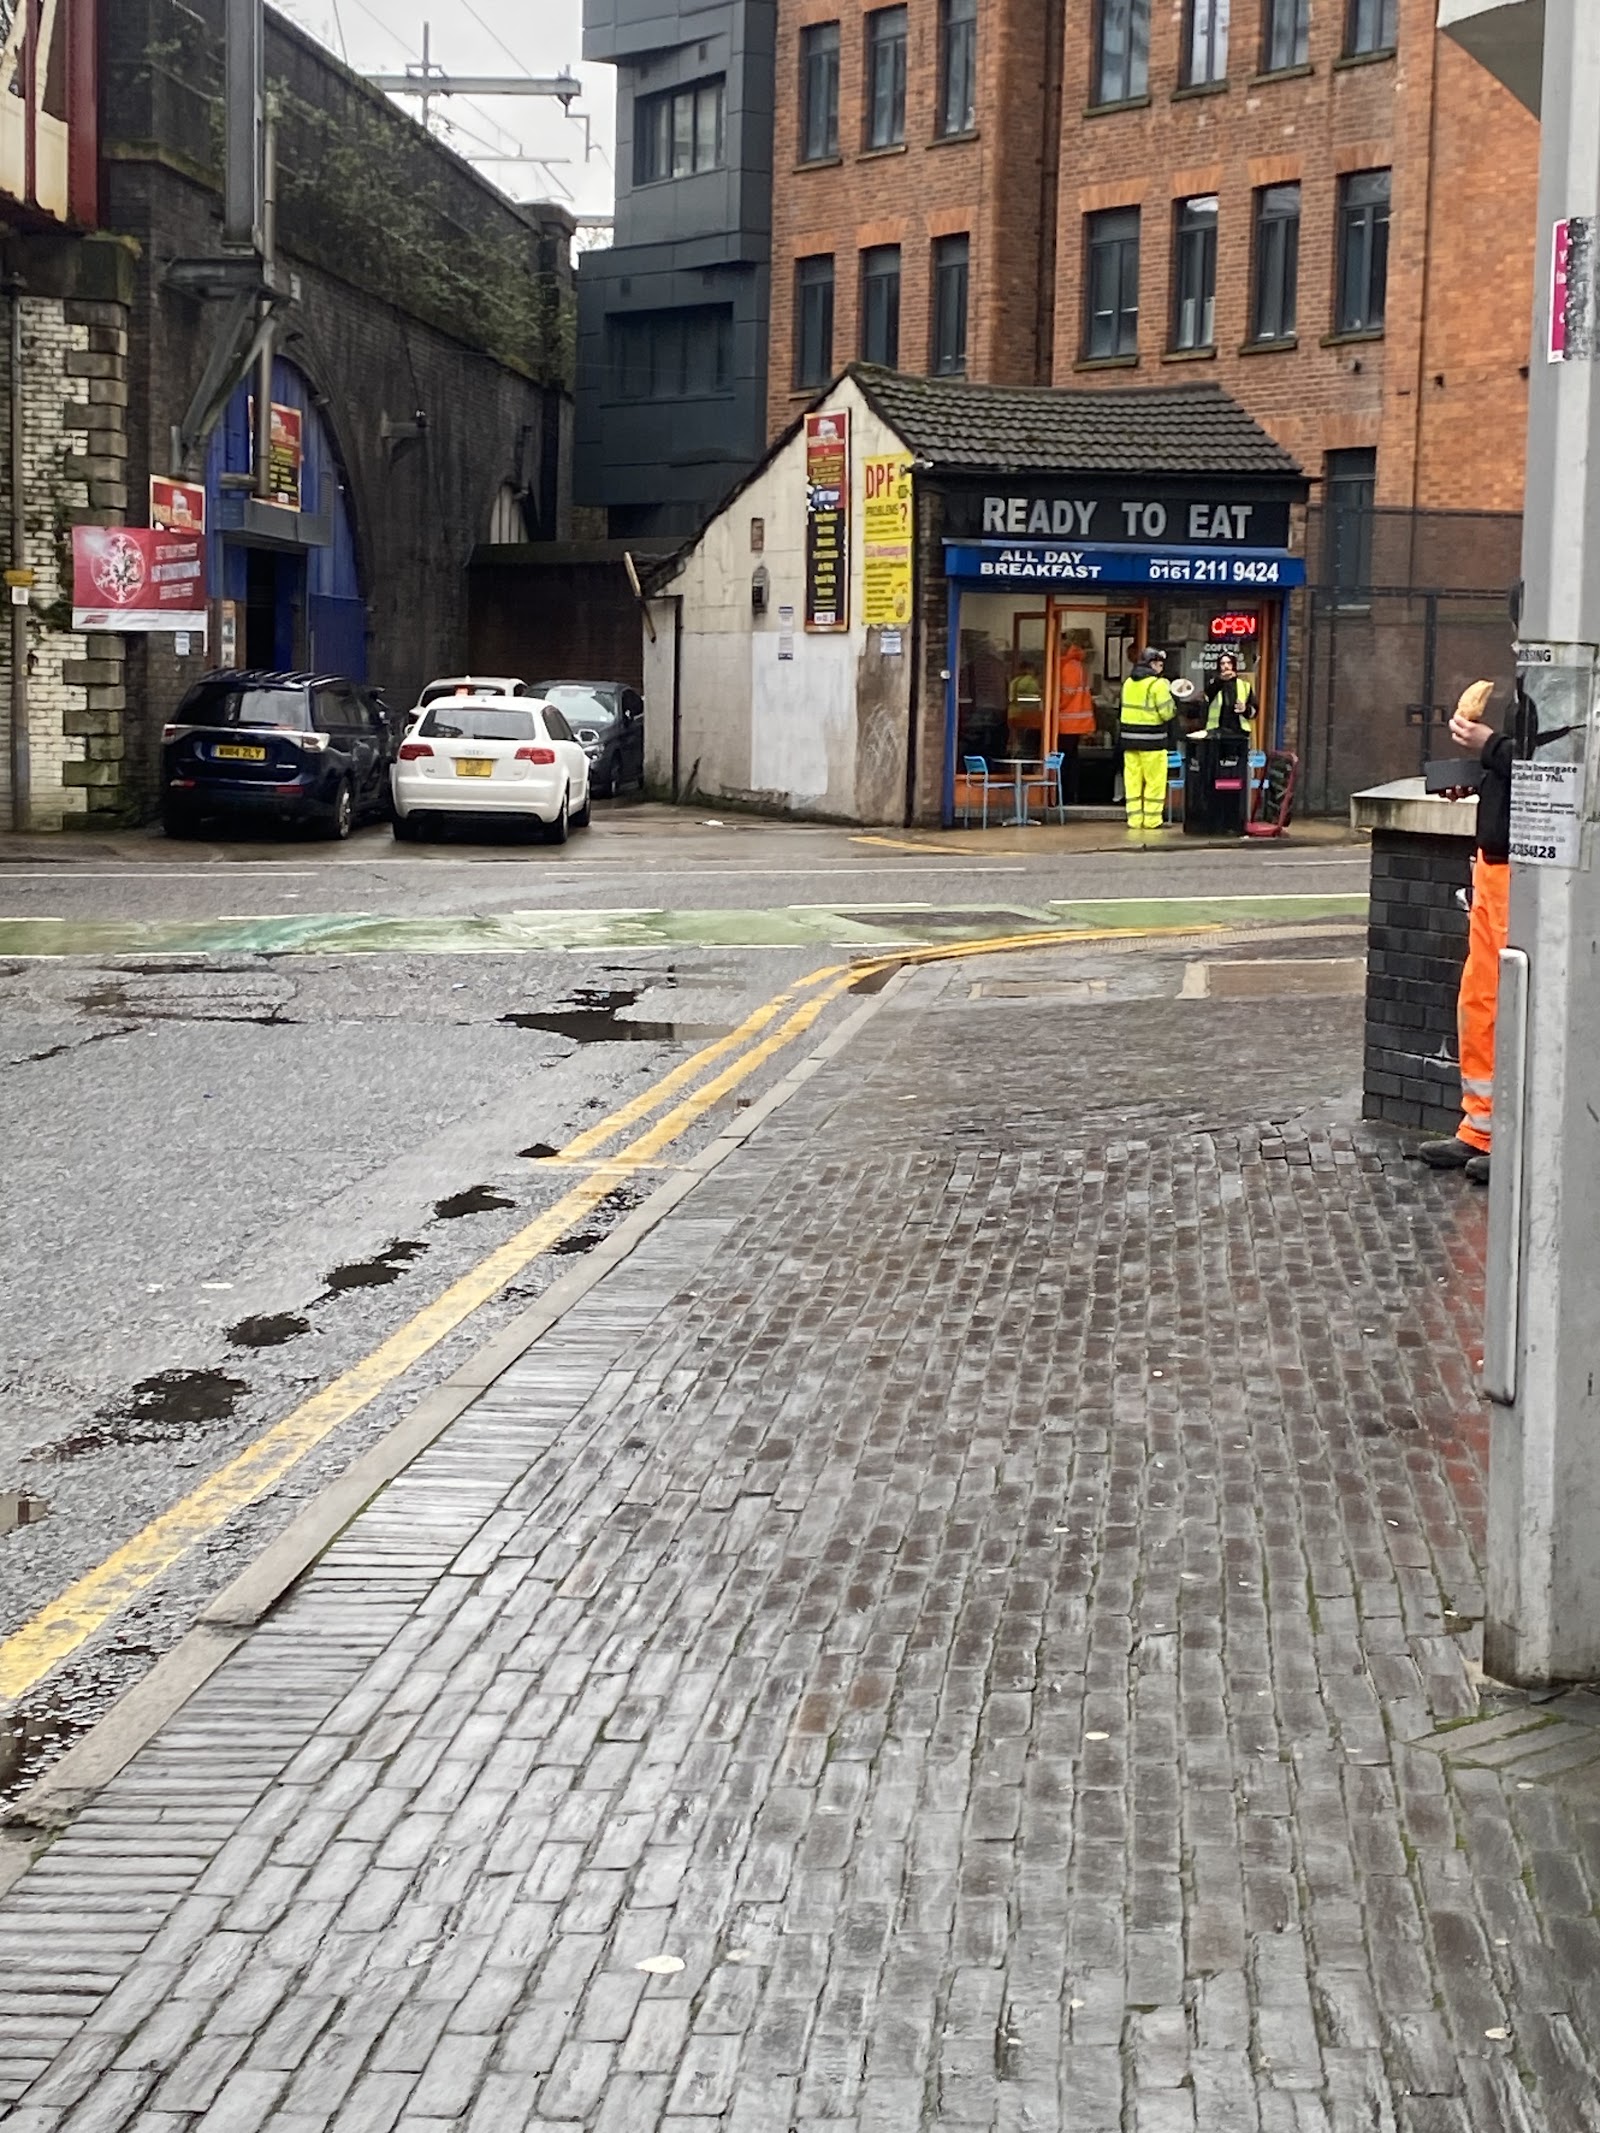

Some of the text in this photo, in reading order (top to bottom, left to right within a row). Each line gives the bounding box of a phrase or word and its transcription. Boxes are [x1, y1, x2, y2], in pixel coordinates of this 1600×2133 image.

[866, 463, 895, 499] DPF
[983, 497, 1253, 539] READY TO EAT
[999, 550, 1084, 564] ALL DAY
[980, 562, 1102, 579] BREAKFAST
[1150, 560, 1280, 582] 0161 211 9424
[1211, 616, 1256, 634] OPEN
